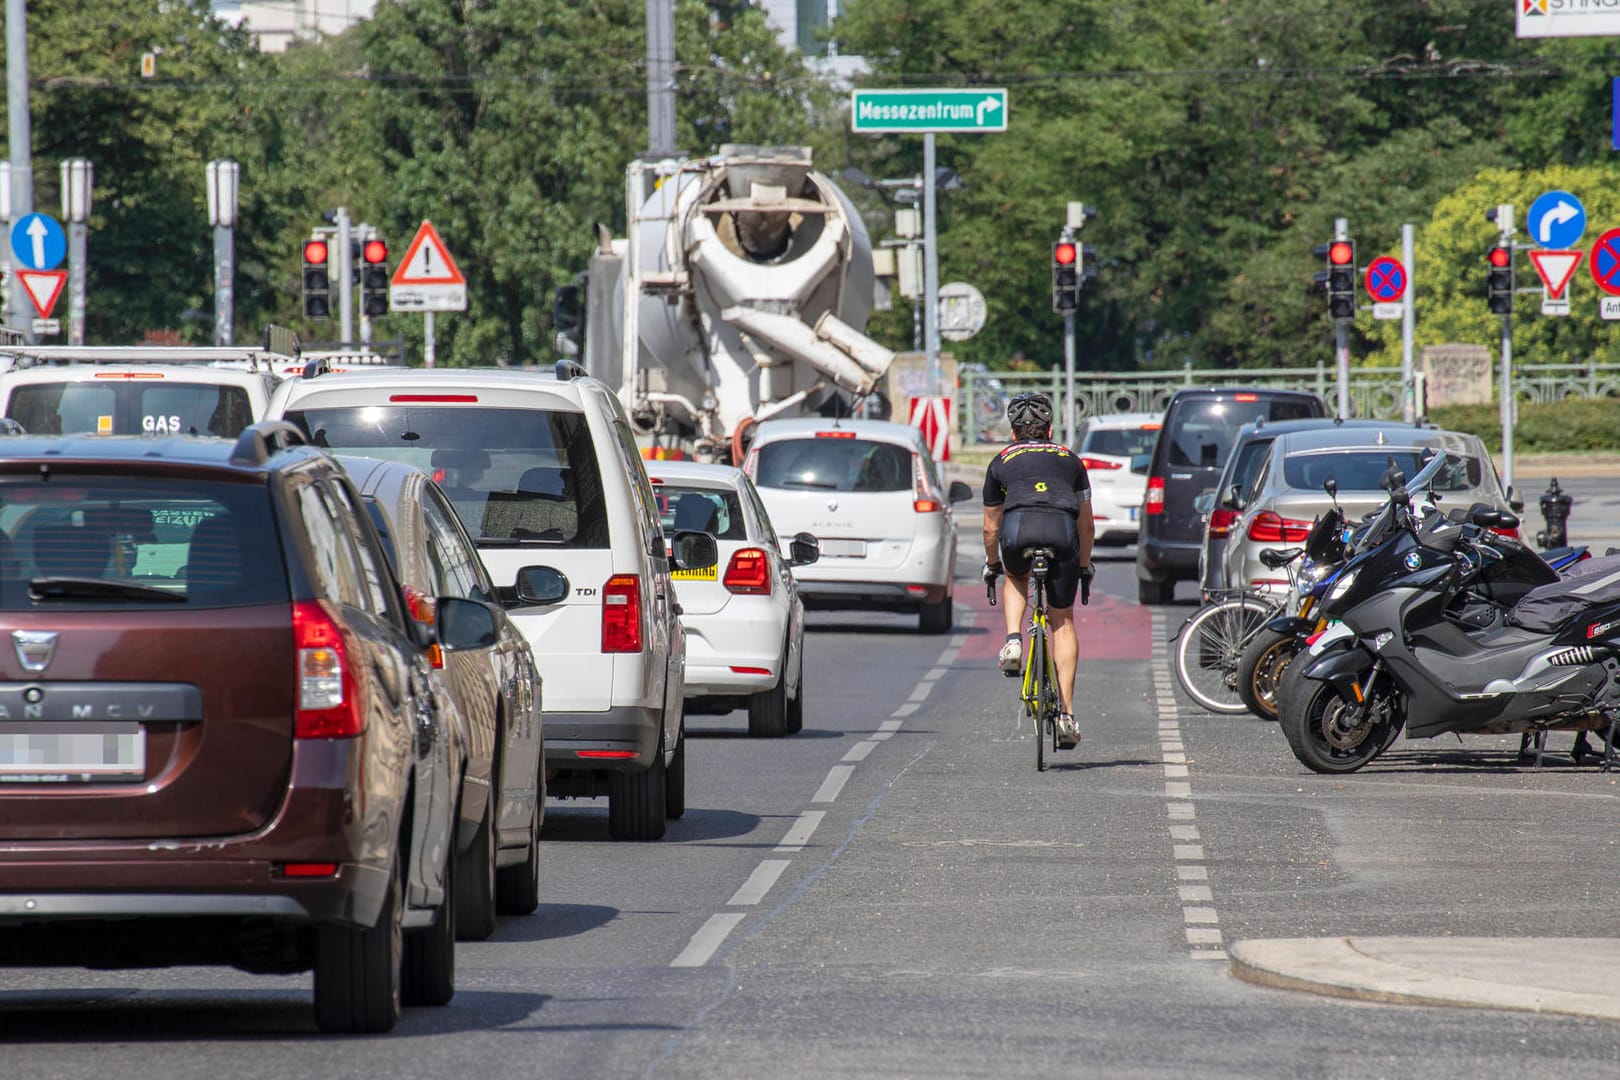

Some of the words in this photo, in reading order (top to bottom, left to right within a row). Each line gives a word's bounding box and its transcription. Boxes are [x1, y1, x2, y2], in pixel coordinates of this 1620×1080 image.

[1550, 0, 1620, 9] STING
[858, 100, 974, 120] Messezentrum
[142, 415, 181, 432] GAS
[575, 588, 597, 596] TDI
[72, 704, 154, 718] MCV
